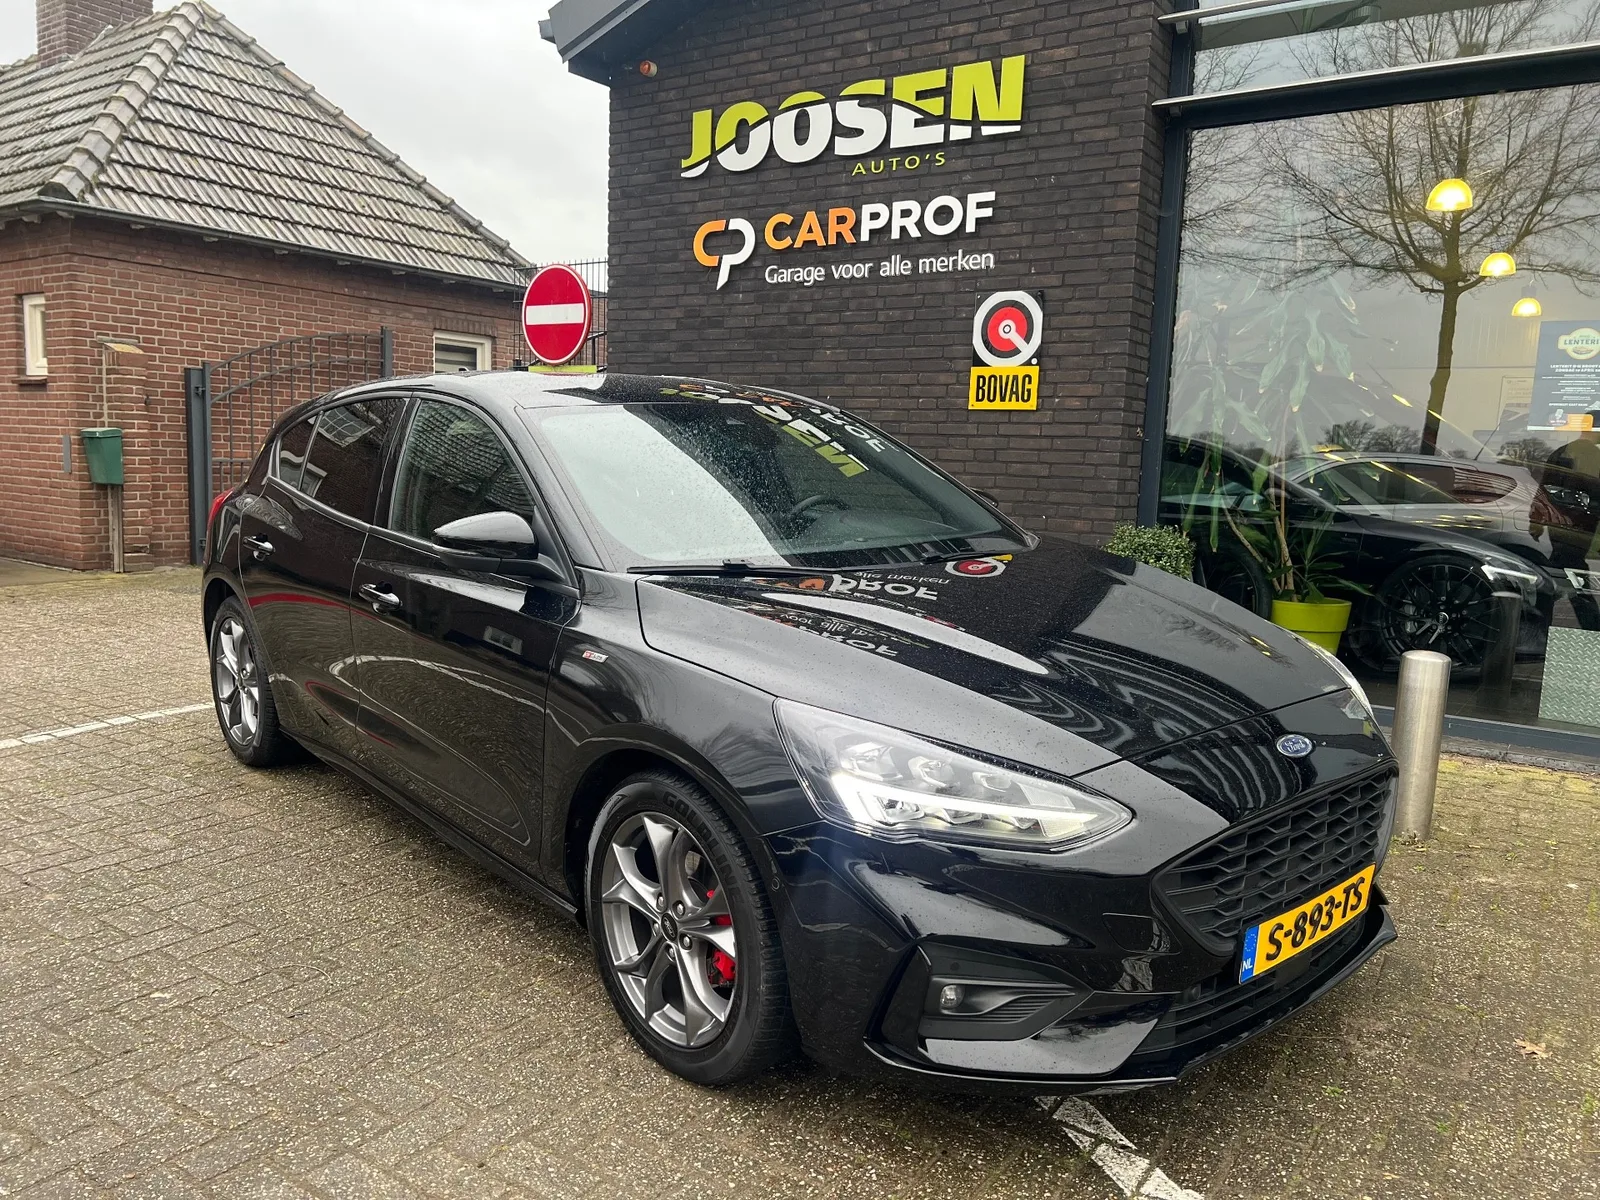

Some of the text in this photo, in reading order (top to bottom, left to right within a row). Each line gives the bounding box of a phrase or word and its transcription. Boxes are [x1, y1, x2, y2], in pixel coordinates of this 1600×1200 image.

[681, 55, 1026, 178] JOOSEN
[851, 152, 946, 176] AUTO'S
[764, 191, 996, 250] CARPROF
[764, 248, 995, 286] Garage voor alle merken
[975, 373, 1033, 403] BOVAG
[1265, 876, 1365, 961] S-893-TS
[1242, 957, 1253, 972] NL
